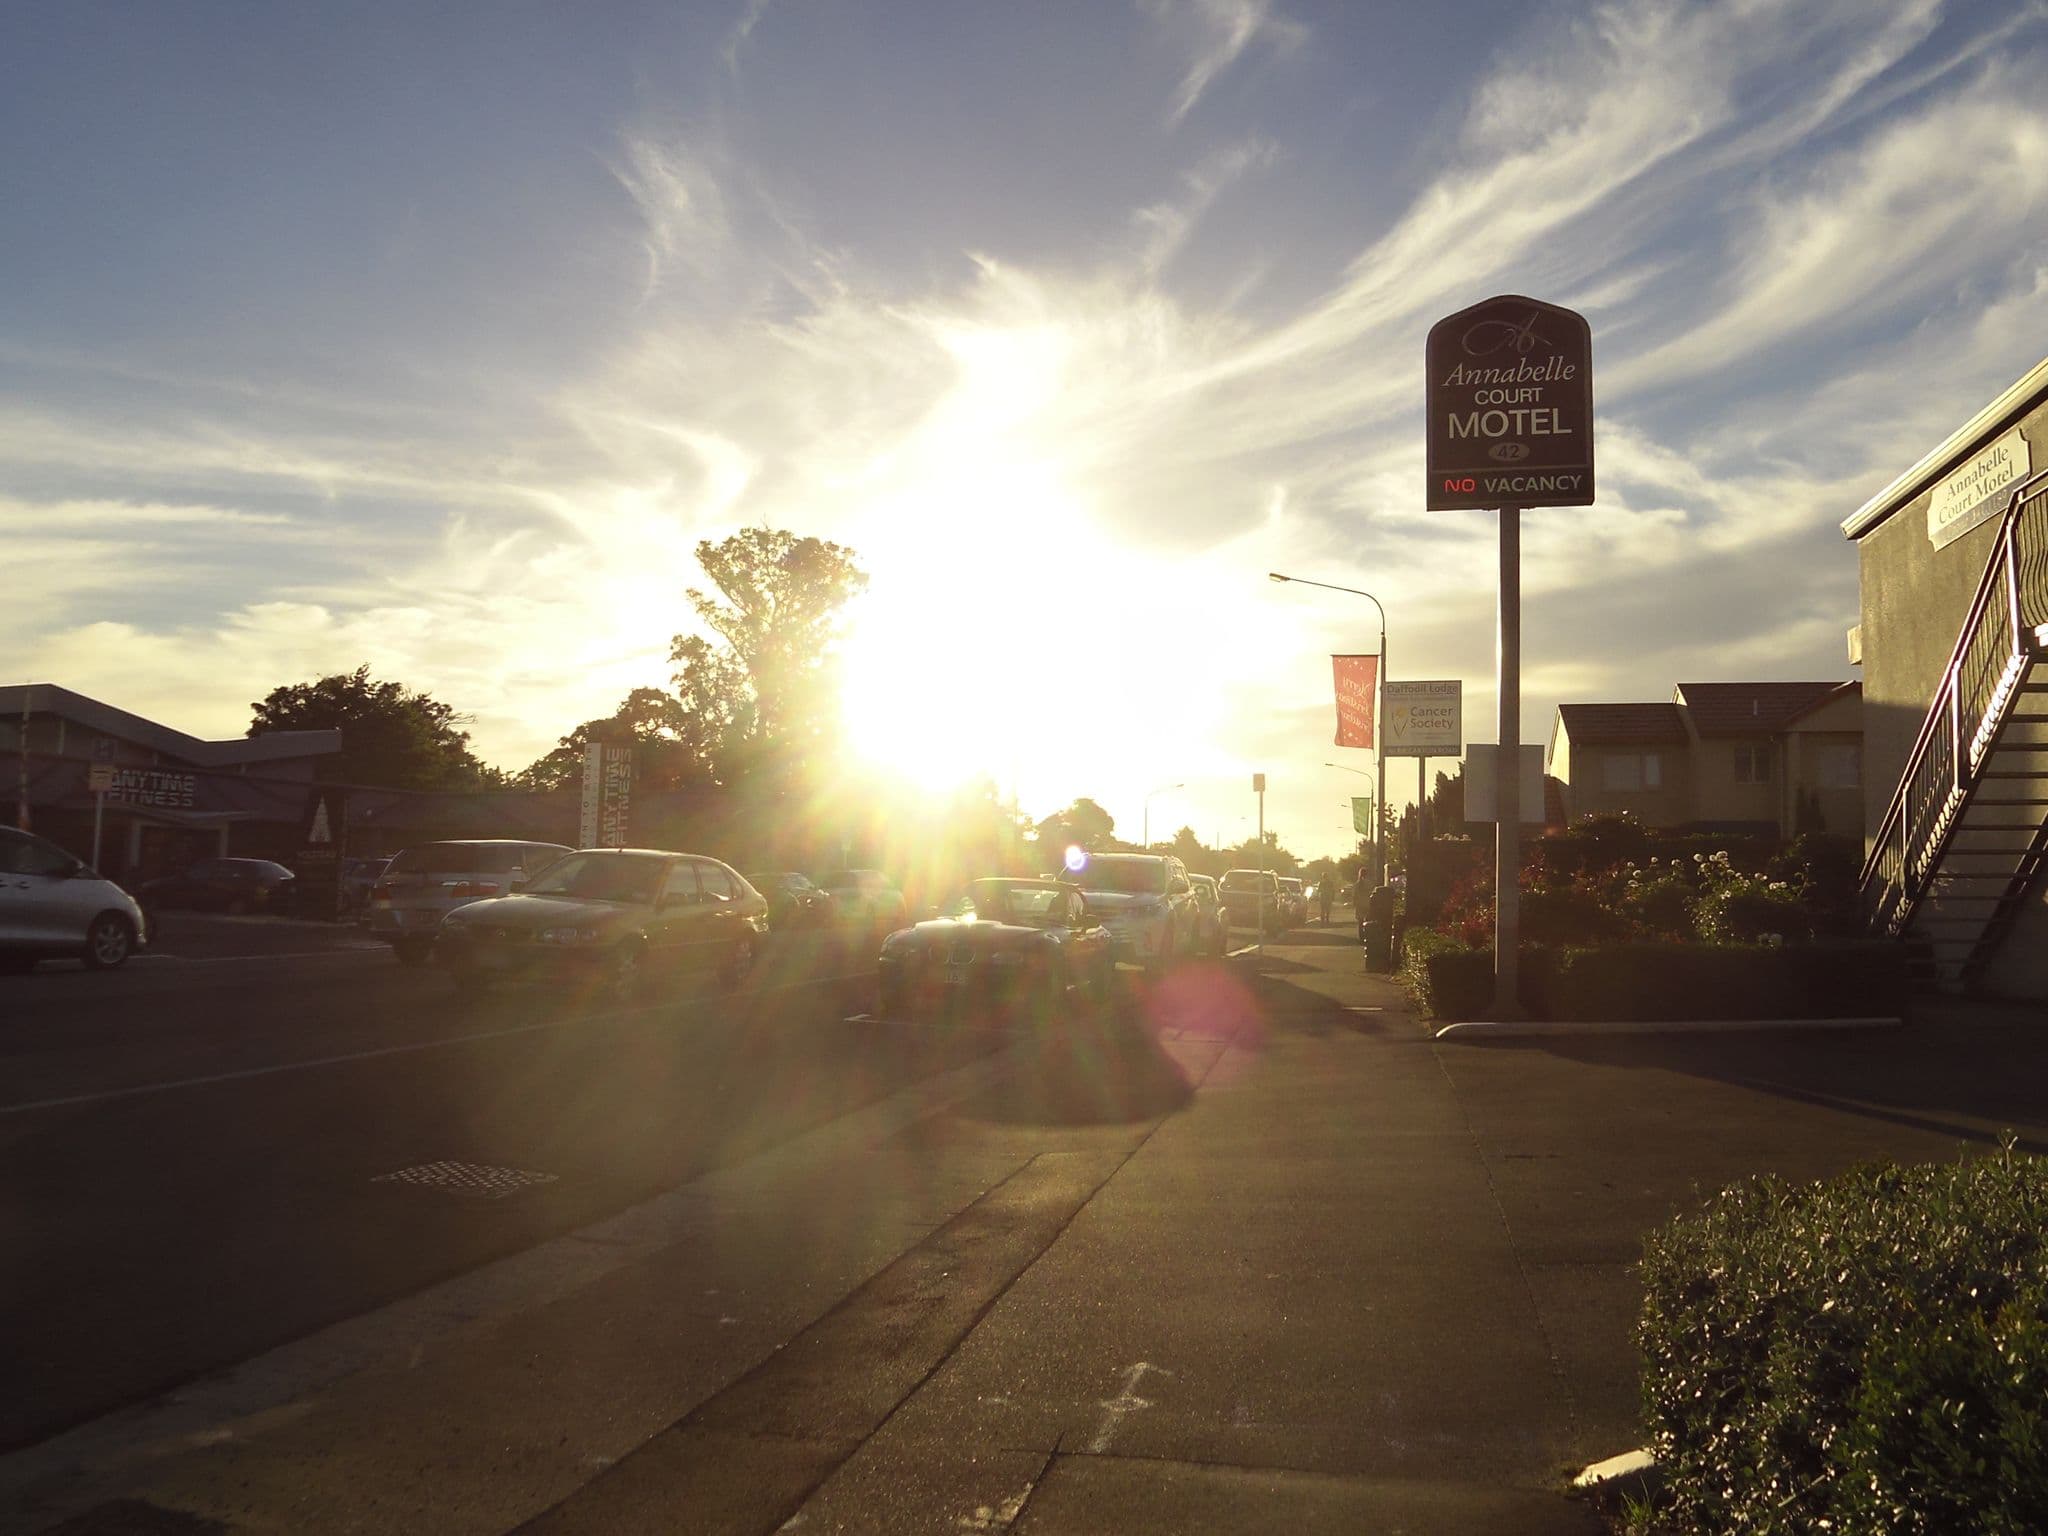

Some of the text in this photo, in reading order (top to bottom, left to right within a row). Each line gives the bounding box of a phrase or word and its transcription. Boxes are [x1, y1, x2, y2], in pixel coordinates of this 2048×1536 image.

[1441, 355, 1576, 387] Annabelle
[1474, 387, 1544, 405] COURT
[1448, 408, 1573, 439] MOTEL
[1496, 444, 1521, 459] 42
[1443, 474, 1582, 494] NO VACANCY
[1946, 446, 2010, 502] Annabelle
[1937, 498, 1973, 525] Court
[1975, 460, 2015, 503] Motel
[1410, 705, 1454, 717] Cancer
[1409, 718, 1454, 730] Society
